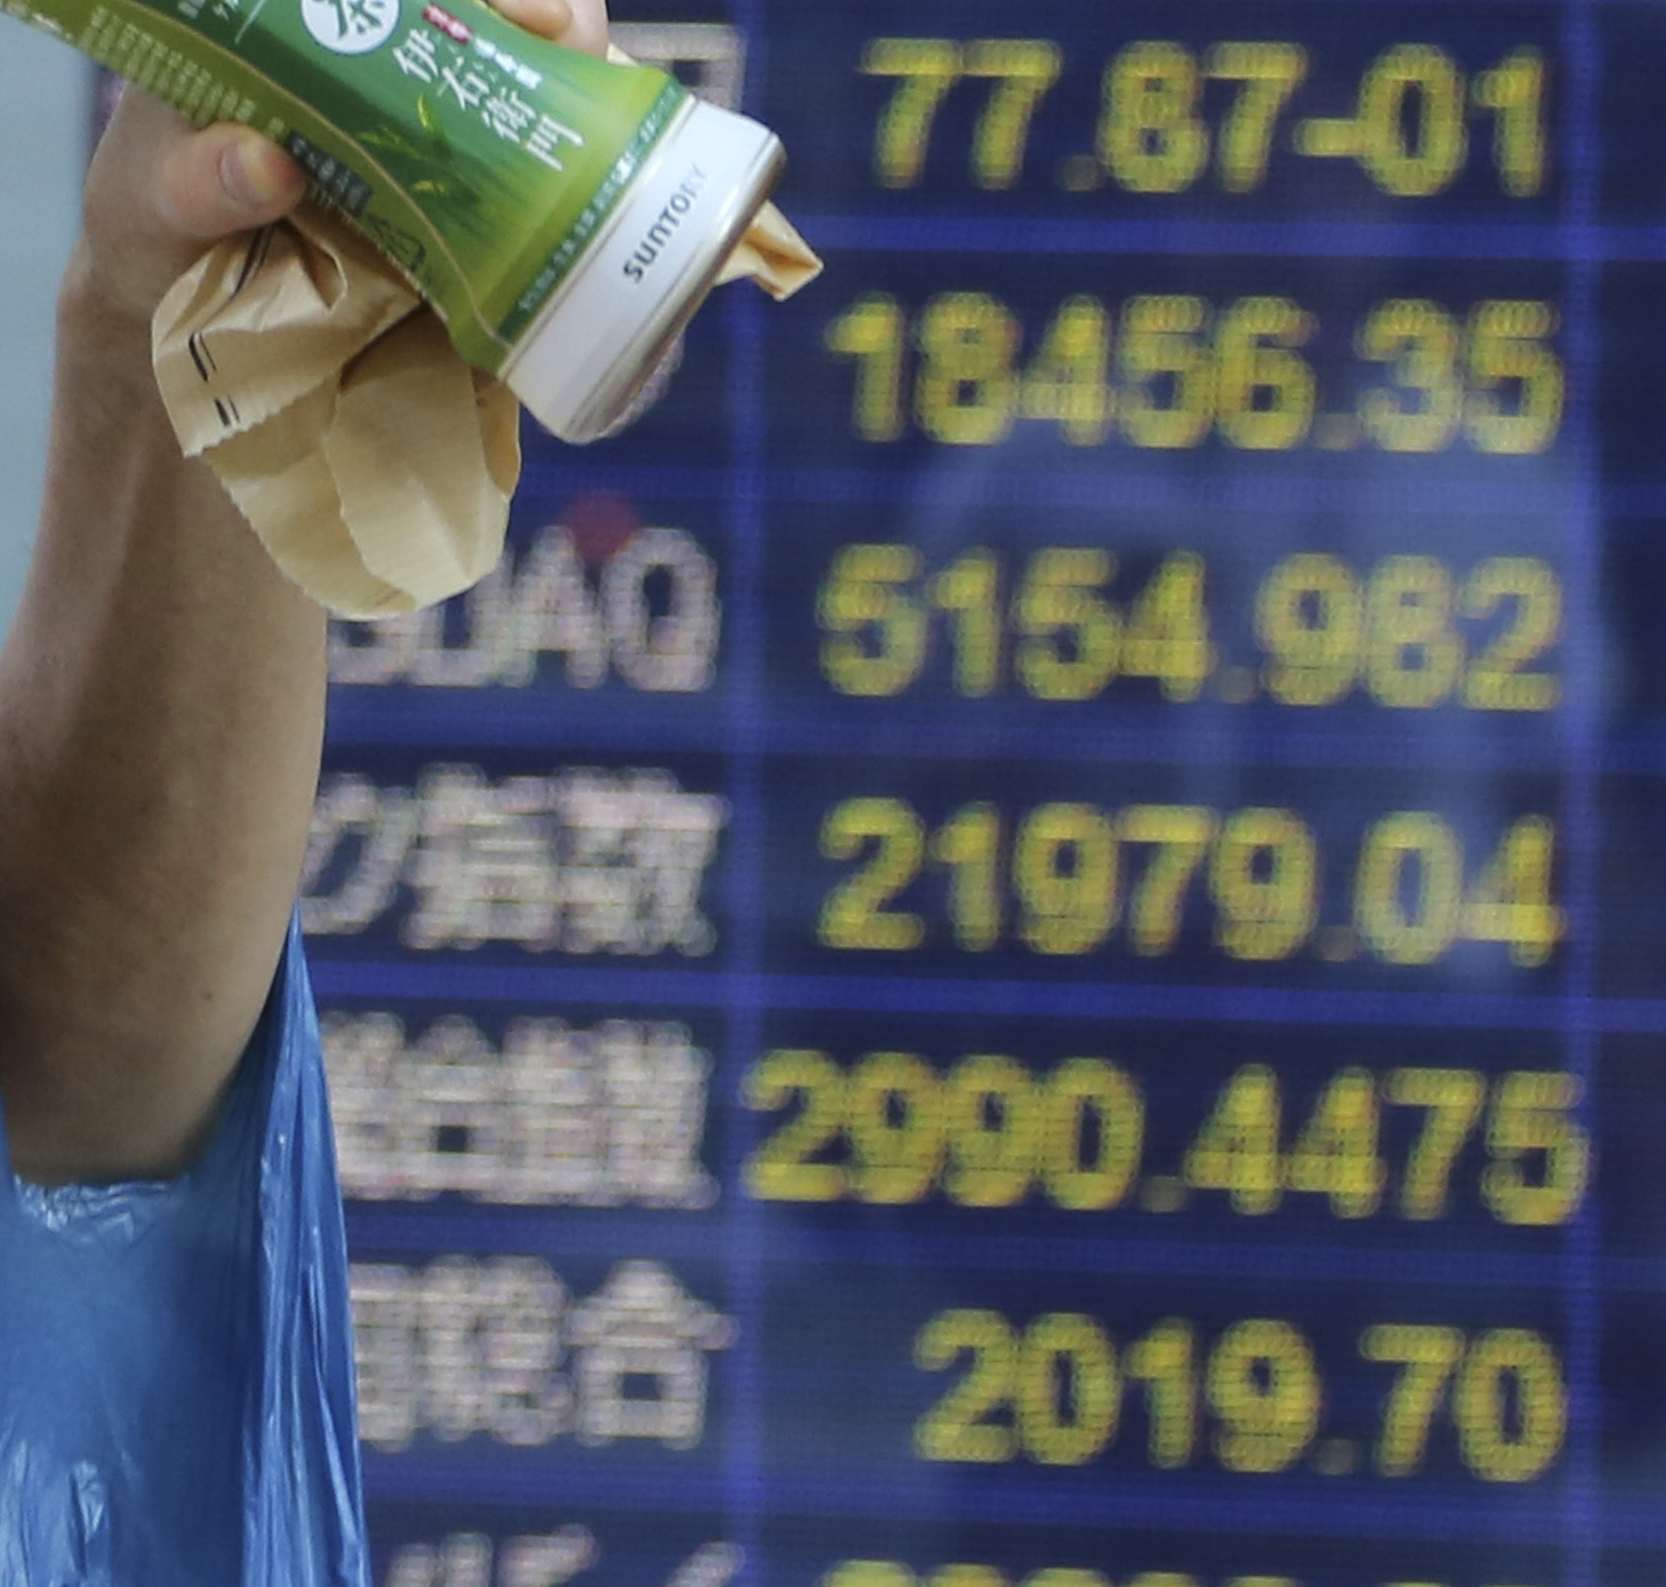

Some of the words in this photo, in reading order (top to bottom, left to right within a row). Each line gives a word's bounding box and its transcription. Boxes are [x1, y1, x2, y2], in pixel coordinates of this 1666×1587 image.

[392, 29, 584, 171] 伊右衛門
[860, 38, 1549, 198] 77.87-01
[825, 291, 1567, 454] 18456.35
[817, 542, 1563, 712] 5154.982
[818, 796, 1565, 967] 21979.04
[741, 1049, 1592, 1226] 2990.4475
[914, 1308, 1570, 1482] 2019.70
